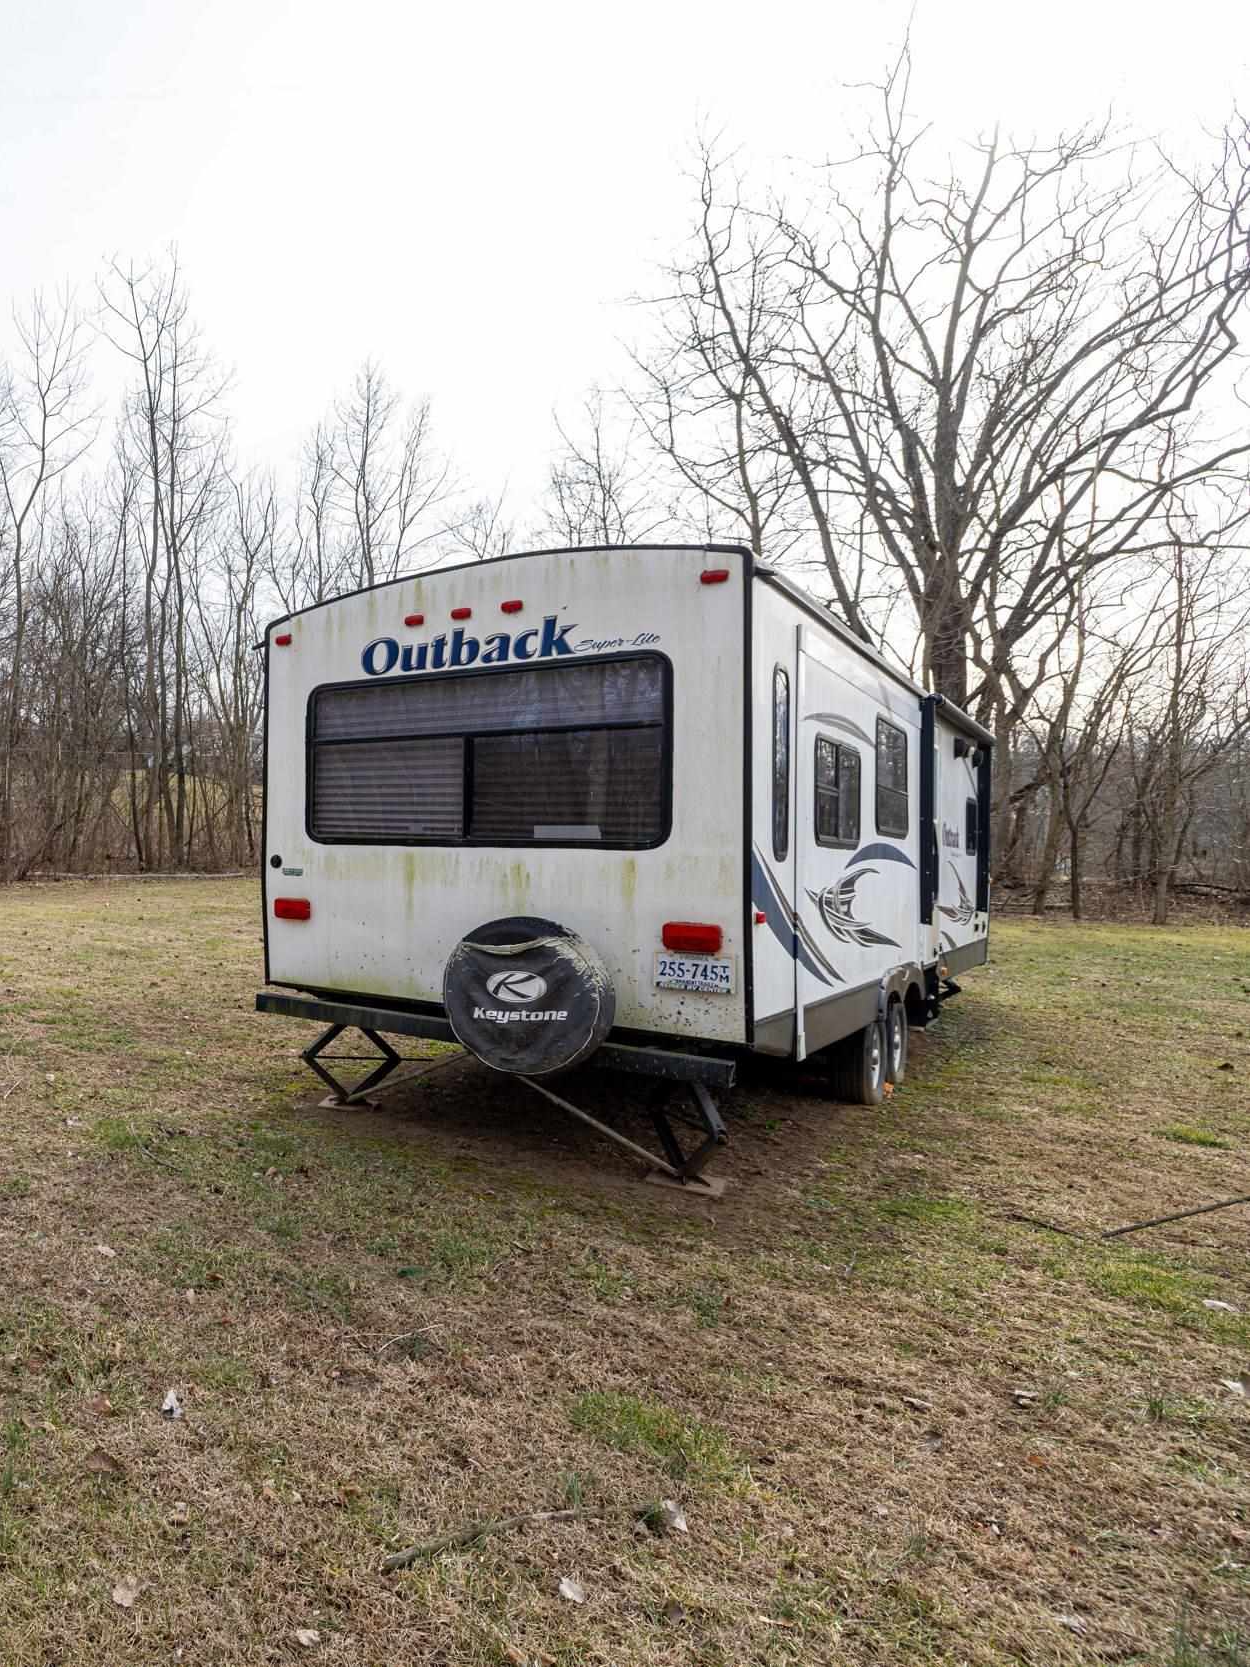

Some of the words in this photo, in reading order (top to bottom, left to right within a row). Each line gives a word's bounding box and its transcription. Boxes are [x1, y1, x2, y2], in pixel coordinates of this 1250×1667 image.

[361, 615, 579, 676] Outback
[659, 960, 719, 982] 255-745
[472, 1006, 568, 1024] Keystone
